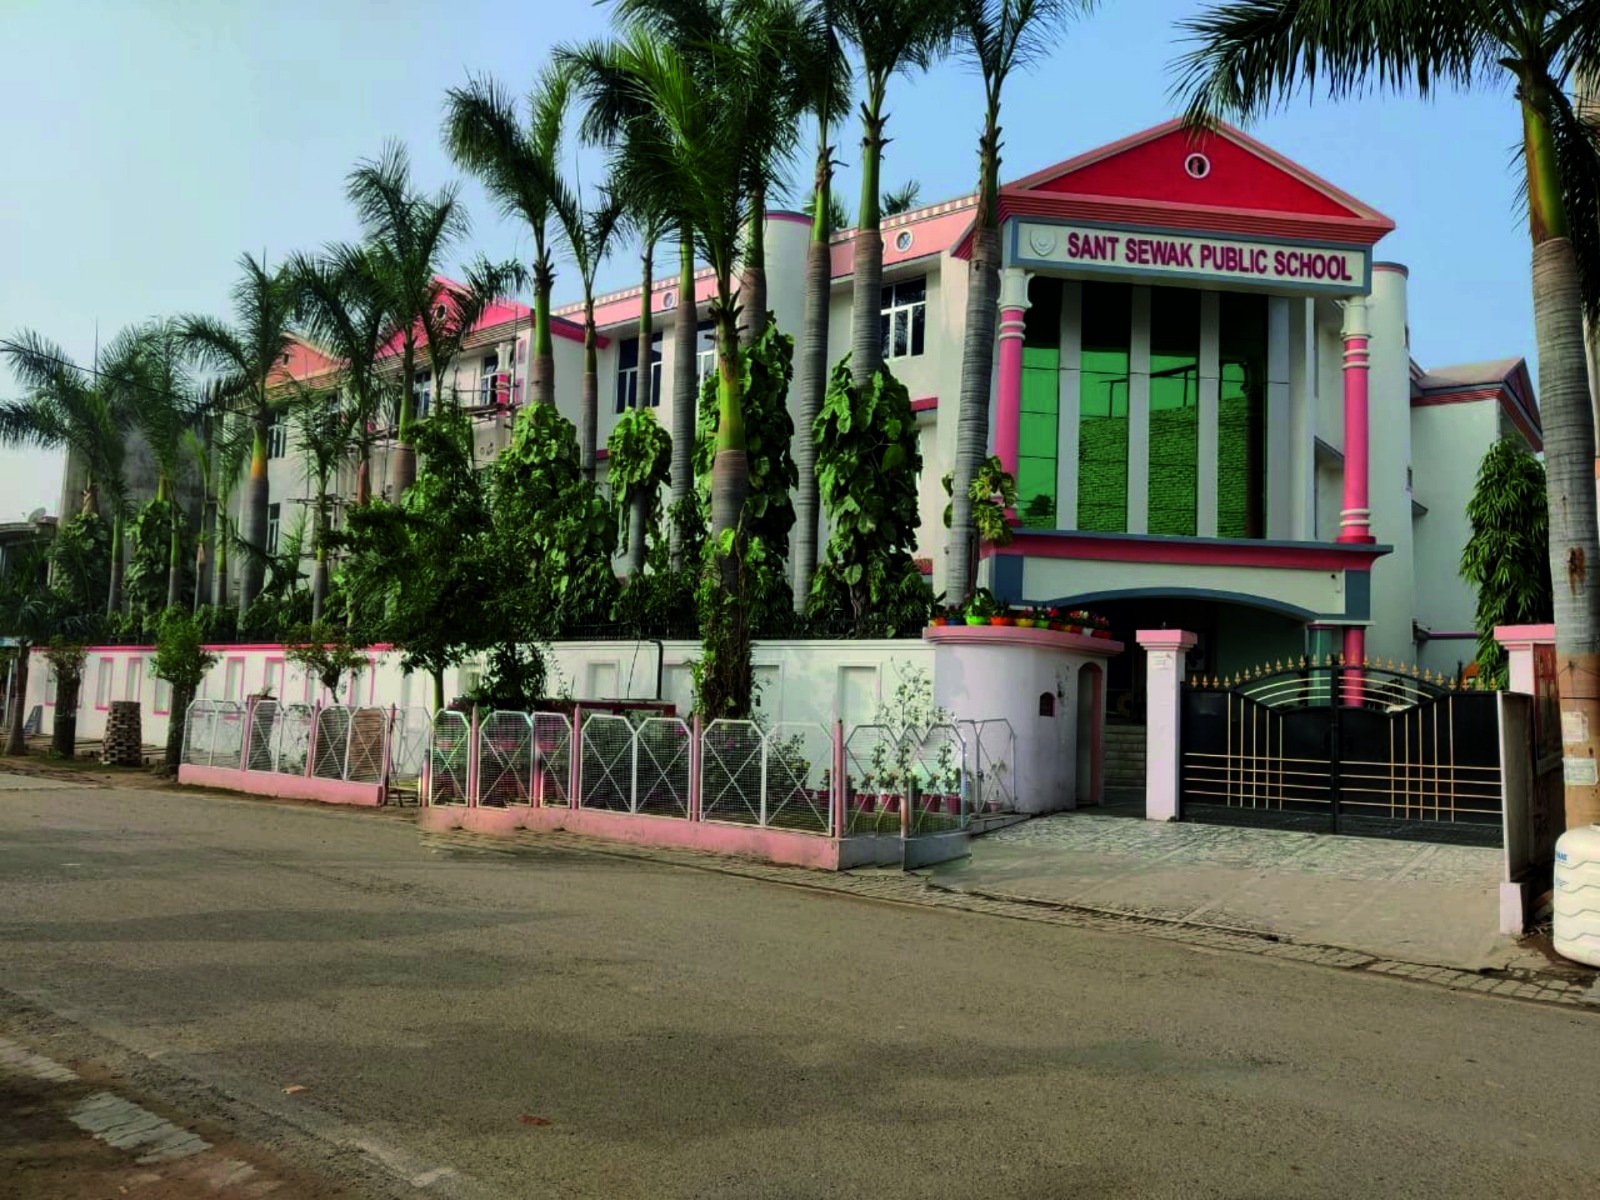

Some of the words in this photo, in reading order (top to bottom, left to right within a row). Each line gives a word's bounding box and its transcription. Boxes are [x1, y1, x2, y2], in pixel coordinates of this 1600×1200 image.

[1067, 232, 1119, 261] SANT
[1125, 238, 1194, 268] SEWAK
[1200, 244, 1268, 275] PUBLIC
[1274, 250, 1352, 281] SCHOOL
